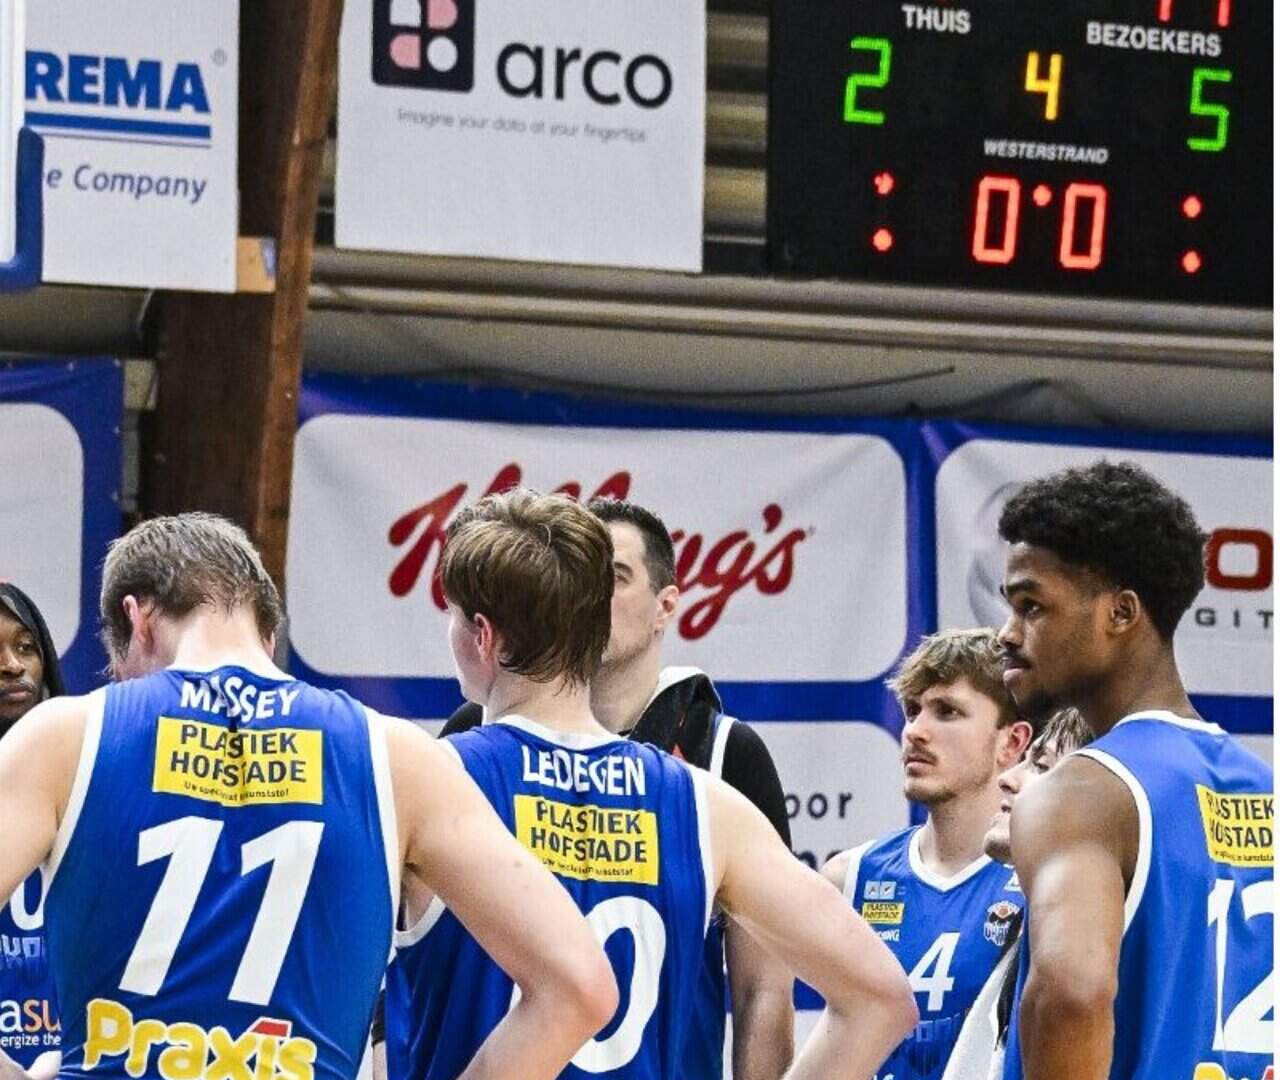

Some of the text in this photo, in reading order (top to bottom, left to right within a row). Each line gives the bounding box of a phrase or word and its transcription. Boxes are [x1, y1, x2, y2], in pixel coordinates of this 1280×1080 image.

[902, 5, 971, 34] THUIS
[1086, 22, 1222, 57] BEZOEKERS
[497, 42, 673, 109] arco
[843, 36, 892, 124] 2
[1025, 51, 1062, 121] 4
[397, 108, 454, 128] Imagine
[459, 116, 489, 129] your
[493, 117, 527, 133] data
[1187, 67, 1232, 152] 5
[984, 139, 1109, 165] WESTERSTRAND
[74, 164, 206, 201] Company
[180, 675, 300, 724] MASSEY
[521, 745, 646, 797] LEDEGEN
[536, 800, 643, 835] PLASTIEK
[530, 826, 648, 864] HOFSTADE
[119, 815, 325, 1007] 11
[909, 932, 961, 1012] 4
